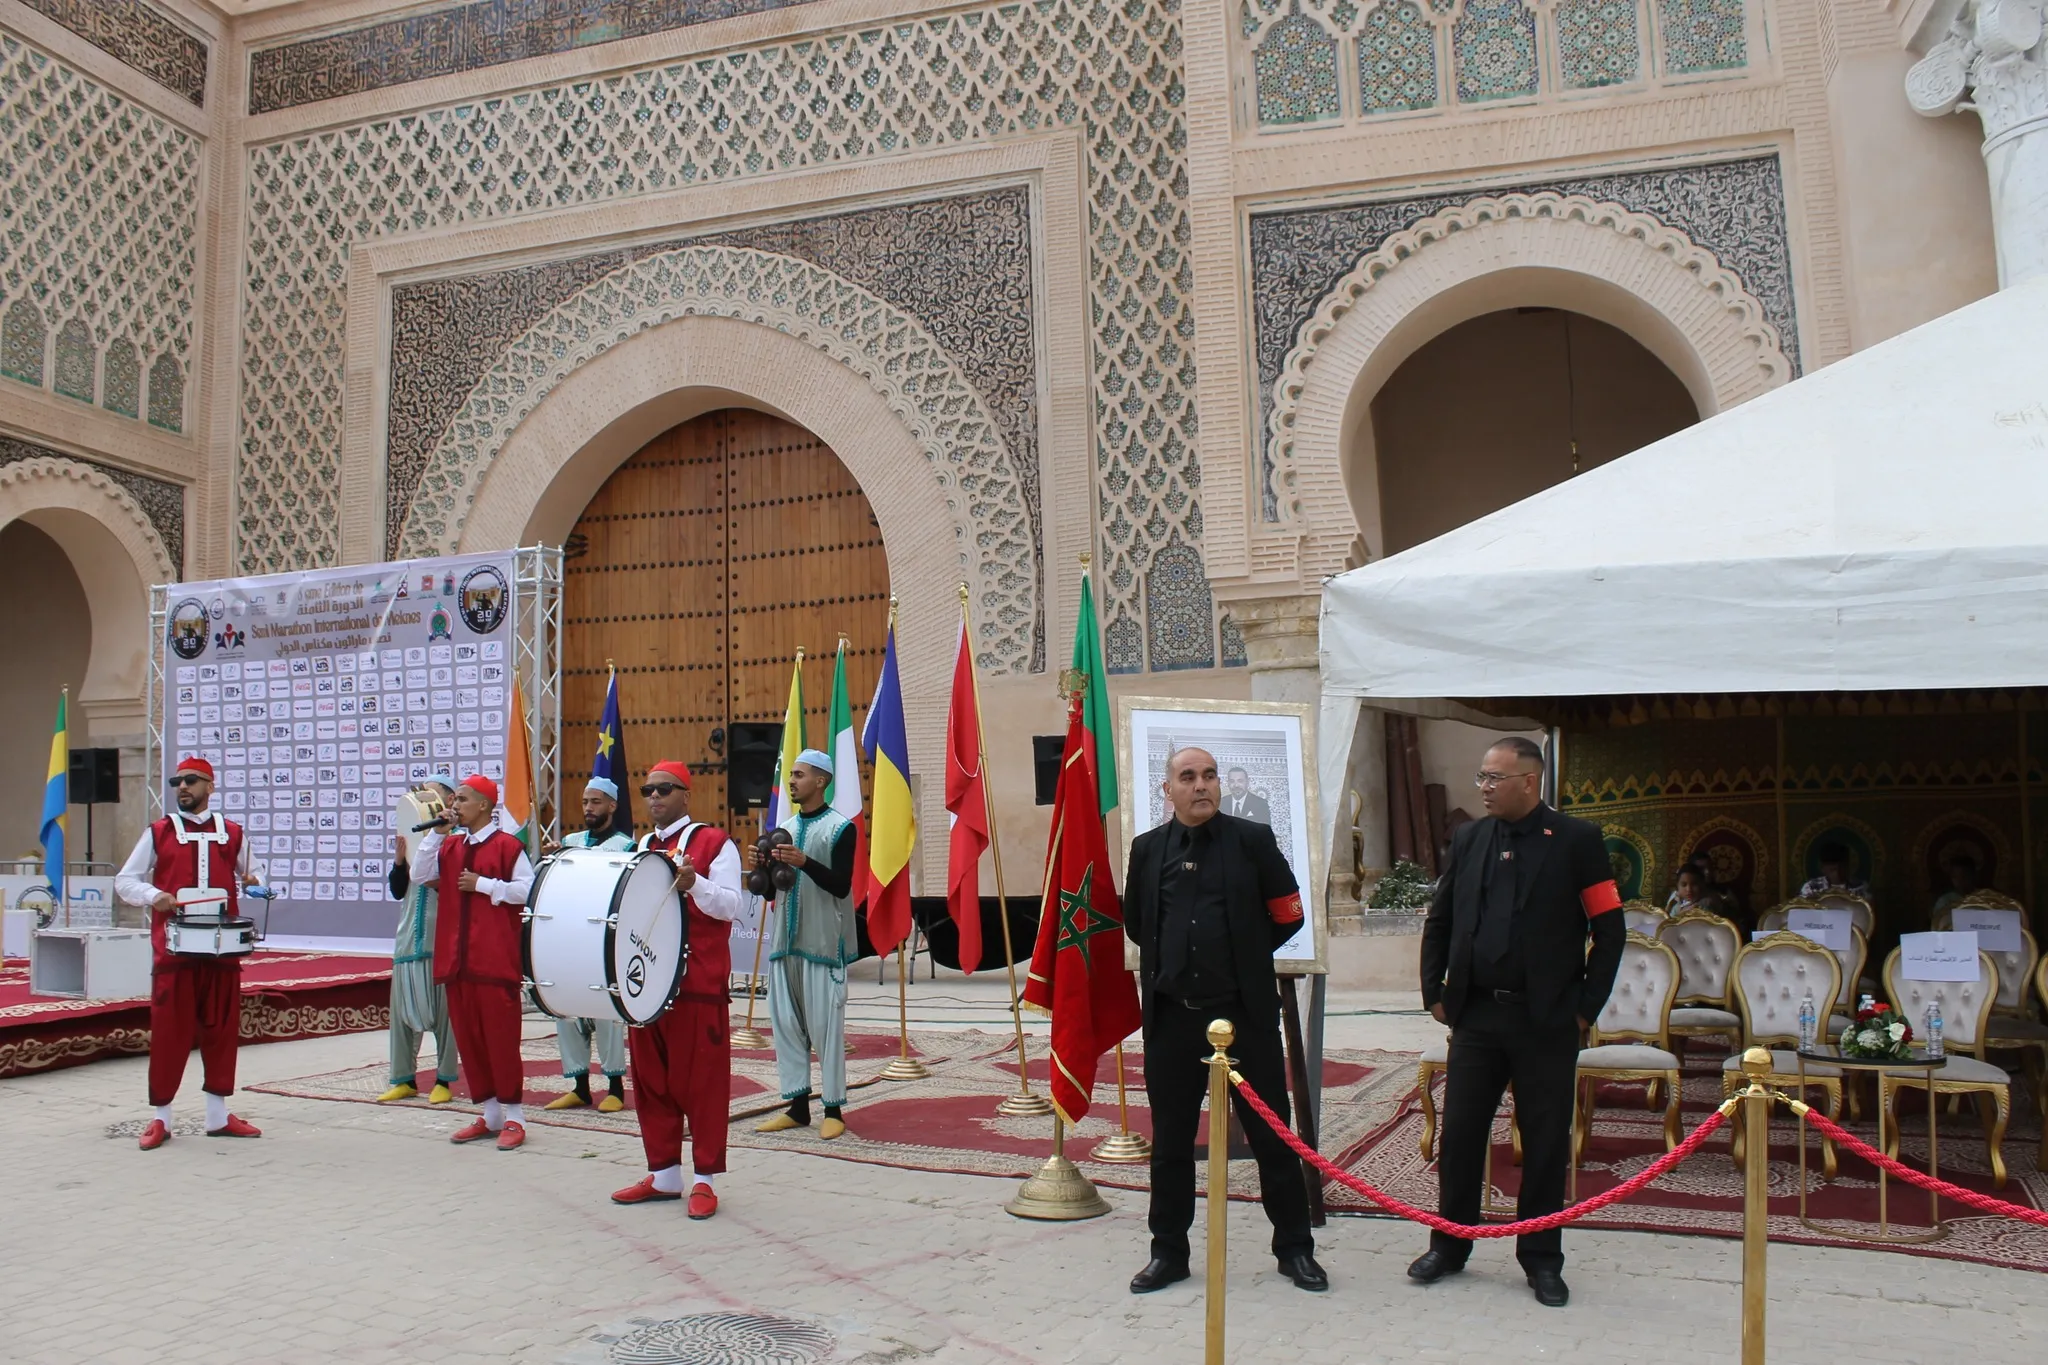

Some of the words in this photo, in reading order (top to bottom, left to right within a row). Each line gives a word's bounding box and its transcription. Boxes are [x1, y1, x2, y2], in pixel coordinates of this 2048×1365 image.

[296, 599, 330, 616] الثامنة
[332, 596, 363, 614] الدورة
[270, 621, 312, 637] Marathon
[314, 615, 370, 634] International
[384, 609, 421, 627] Meknes
[275, 639, 300, 657] الدولي
[302, 637, 333, 653] مكناس
[333, 633, 367, 650] ماراثون
